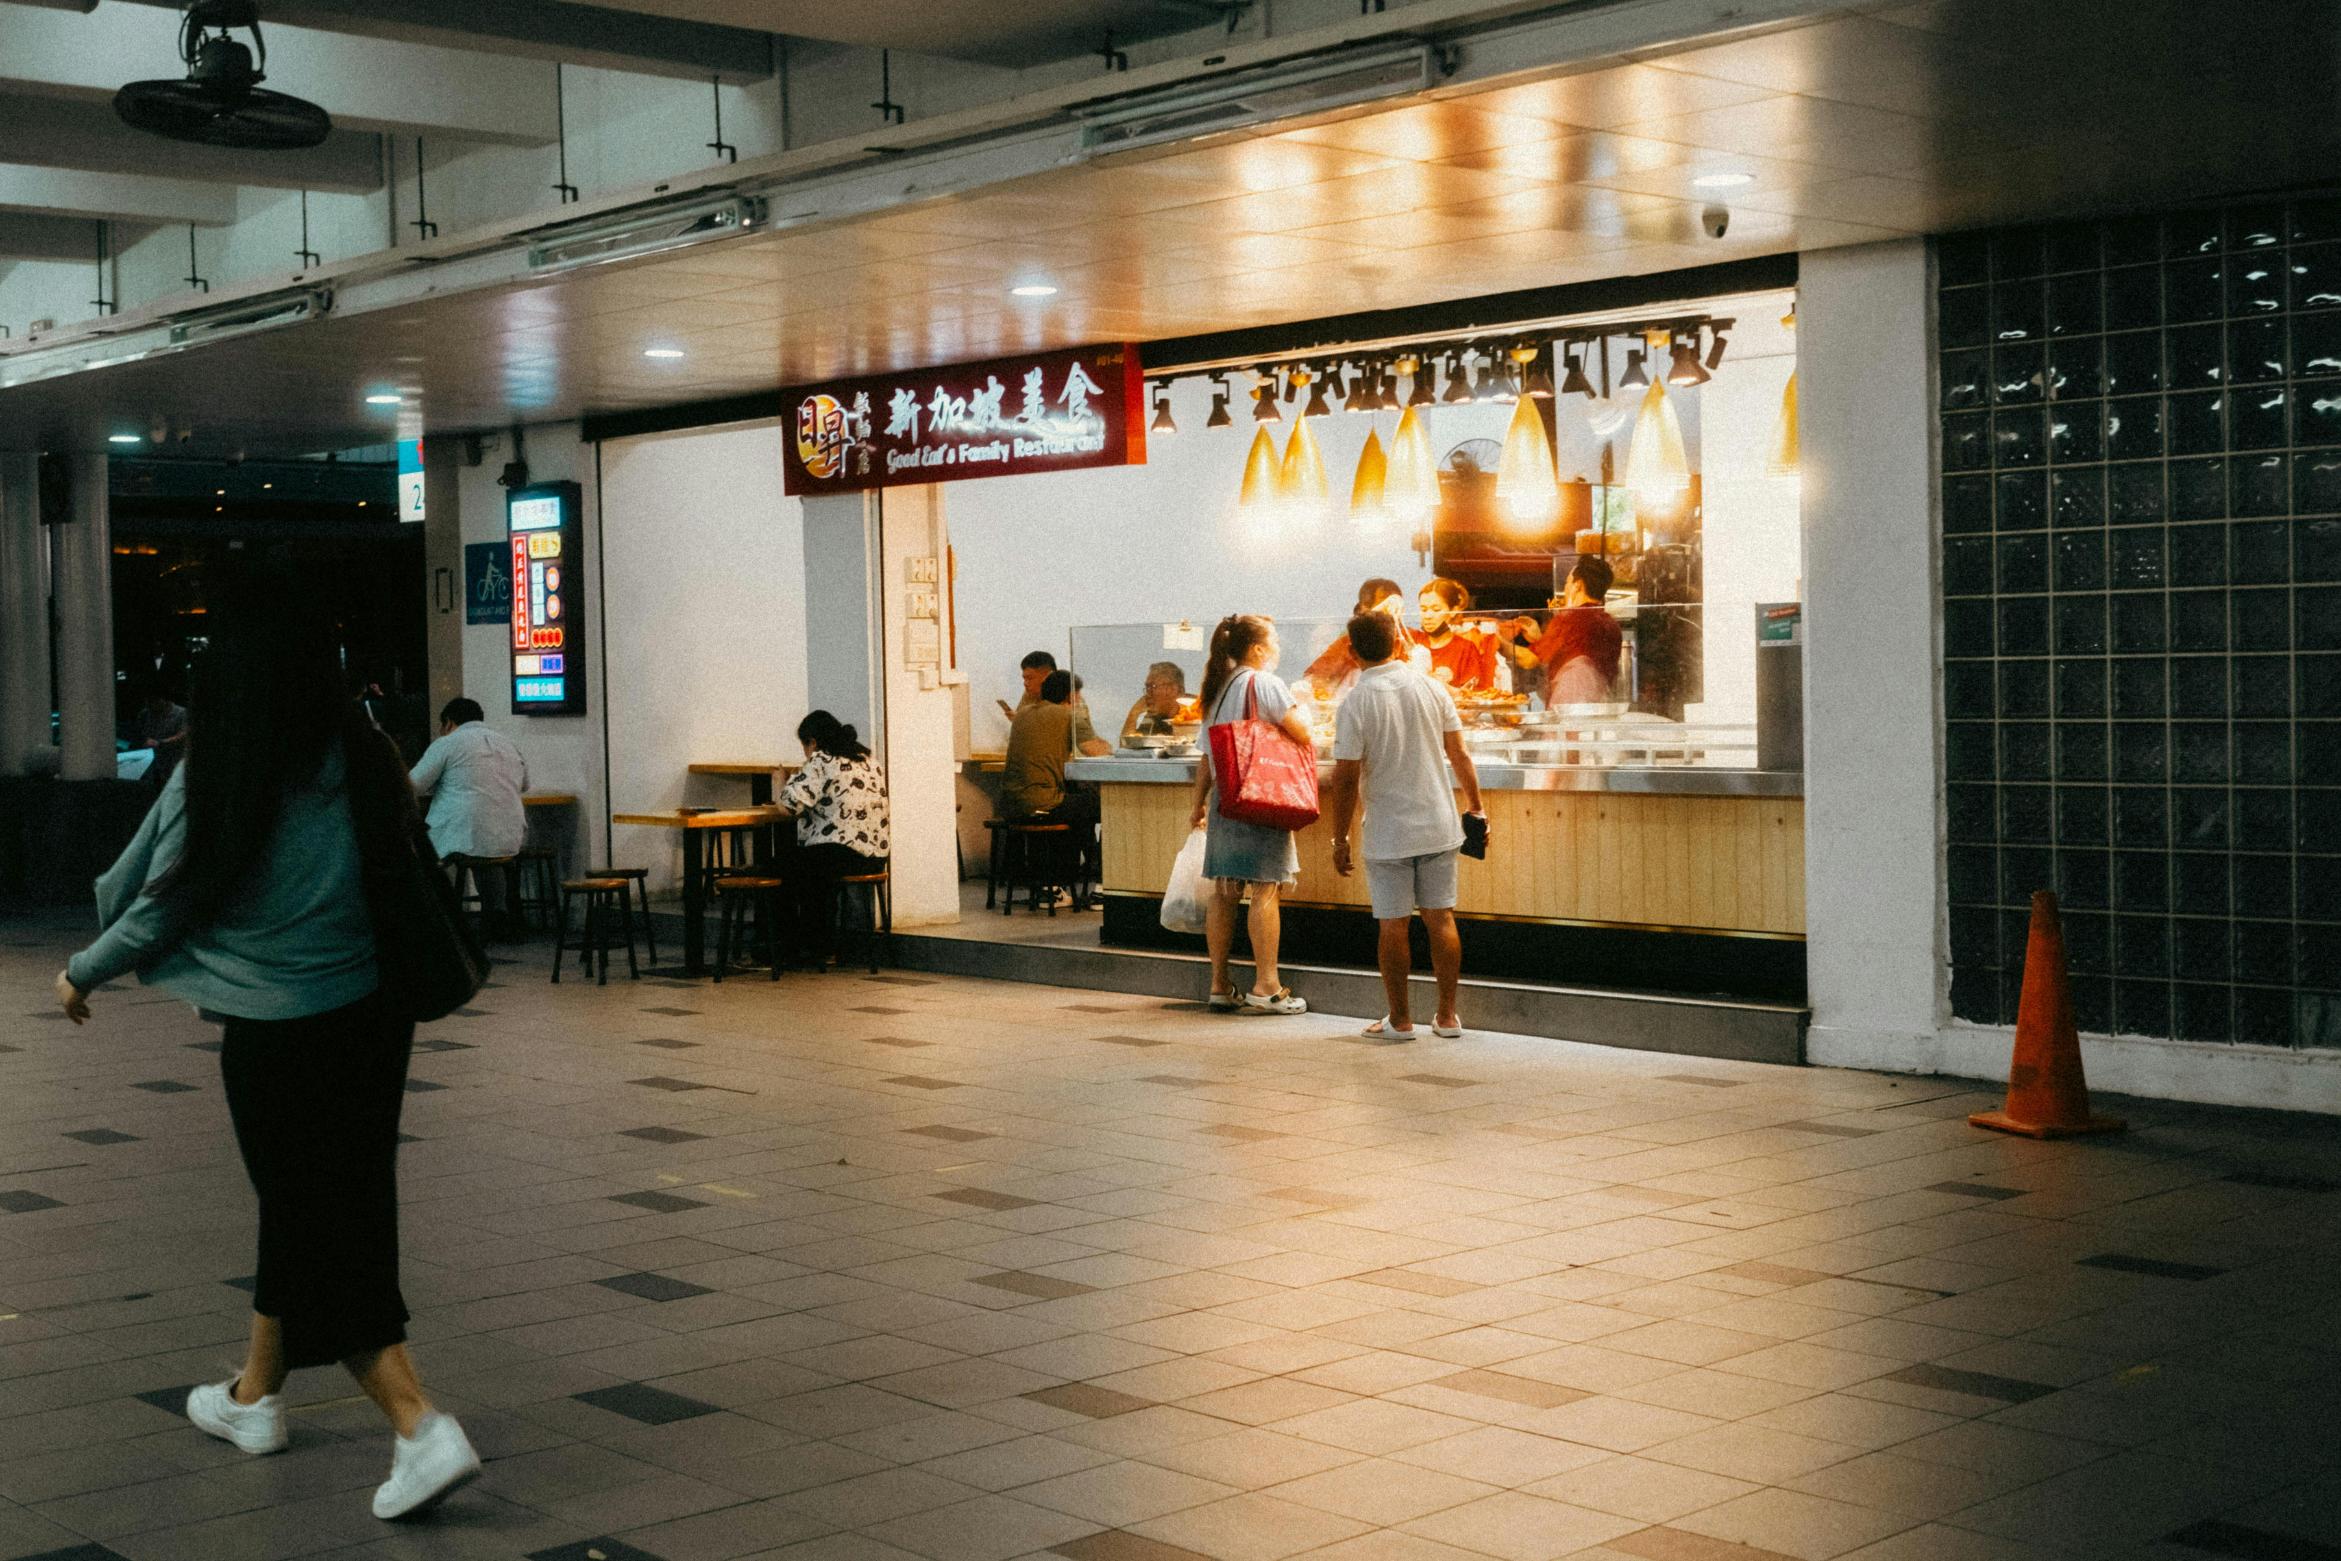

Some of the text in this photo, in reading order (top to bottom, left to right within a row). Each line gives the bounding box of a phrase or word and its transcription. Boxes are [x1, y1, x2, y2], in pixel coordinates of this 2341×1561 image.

[884, 361, 1104, 445] 新加坡美食
[886, 448, 920, 475] Good
[958, 440, 1011, 464] Family
[1013, 433, 1105, 458] Restaurant
